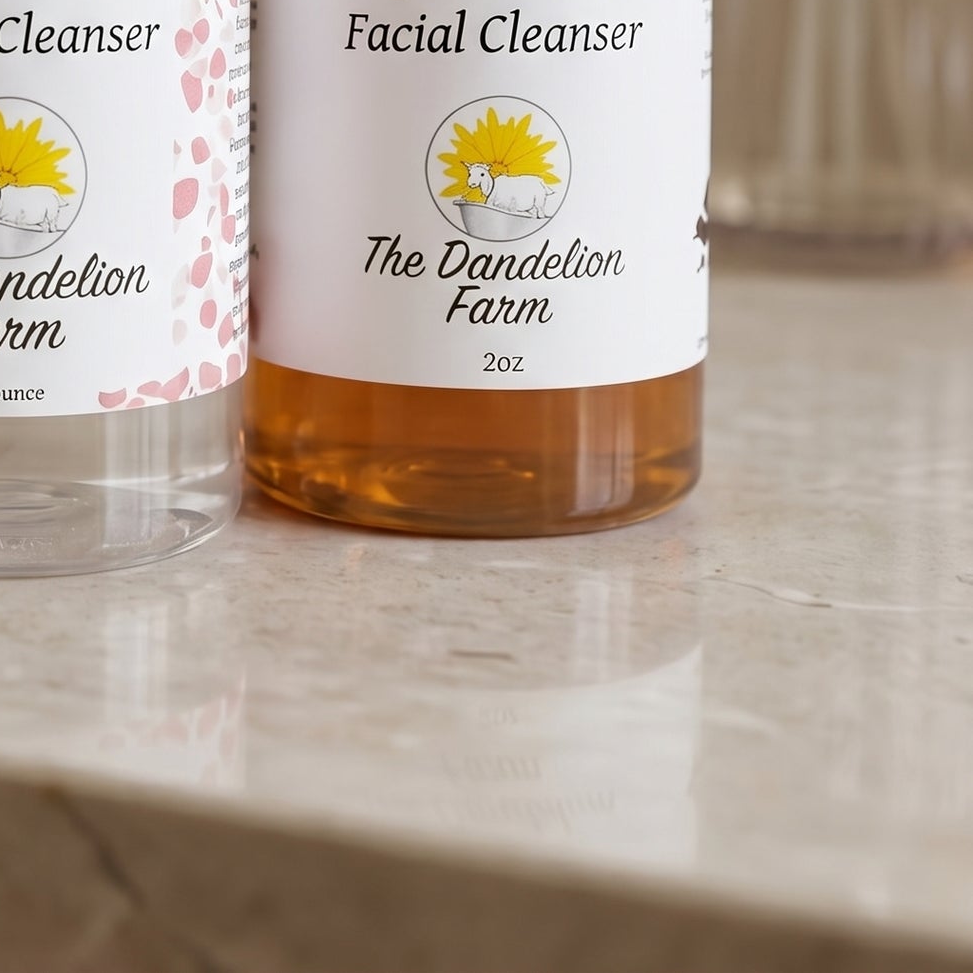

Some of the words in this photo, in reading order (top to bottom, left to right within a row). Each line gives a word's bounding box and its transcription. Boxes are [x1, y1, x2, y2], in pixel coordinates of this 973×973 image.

[343, 8, 467, 54] Facial
[479, 8, 644, 54] Cleanser
[364, 233, 427, 278] The
[437, 237, 626, 281] Dandelion
[445, 284, 554, 325] Farm
[482, 352, 525, 373] 2oz
